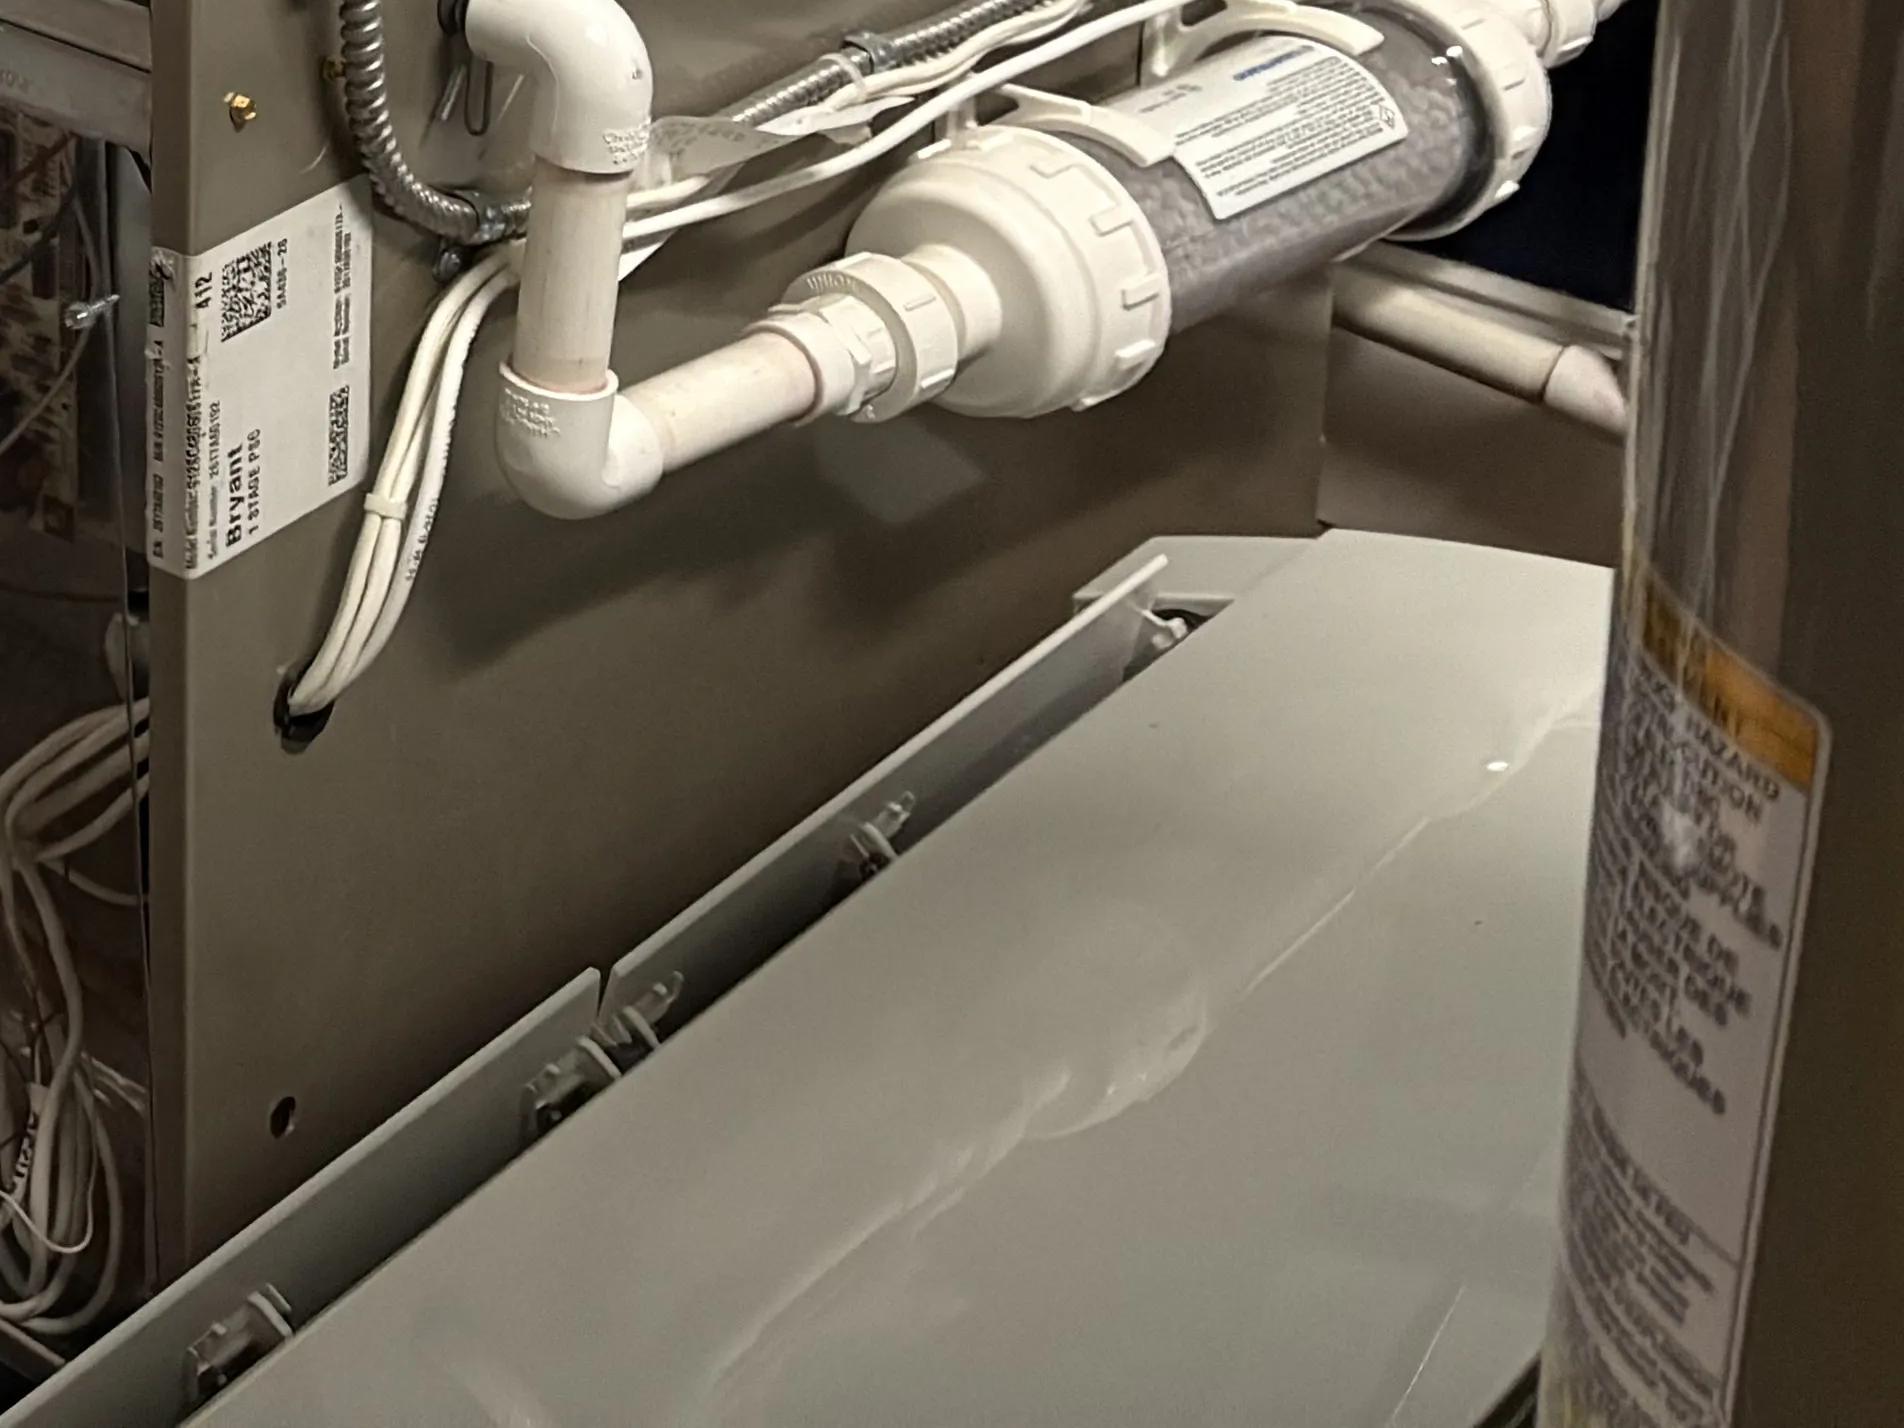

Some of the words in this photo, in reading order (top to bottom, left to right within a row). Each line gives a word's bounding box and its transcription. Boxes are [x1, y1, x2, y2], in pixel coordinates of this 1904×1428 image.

[247, 428, 261, 463] PSC
[225, 442, 245, 547] Bryant
[247, 466, 261, 521] STAGE
[248, 524, 259, 536] 1
